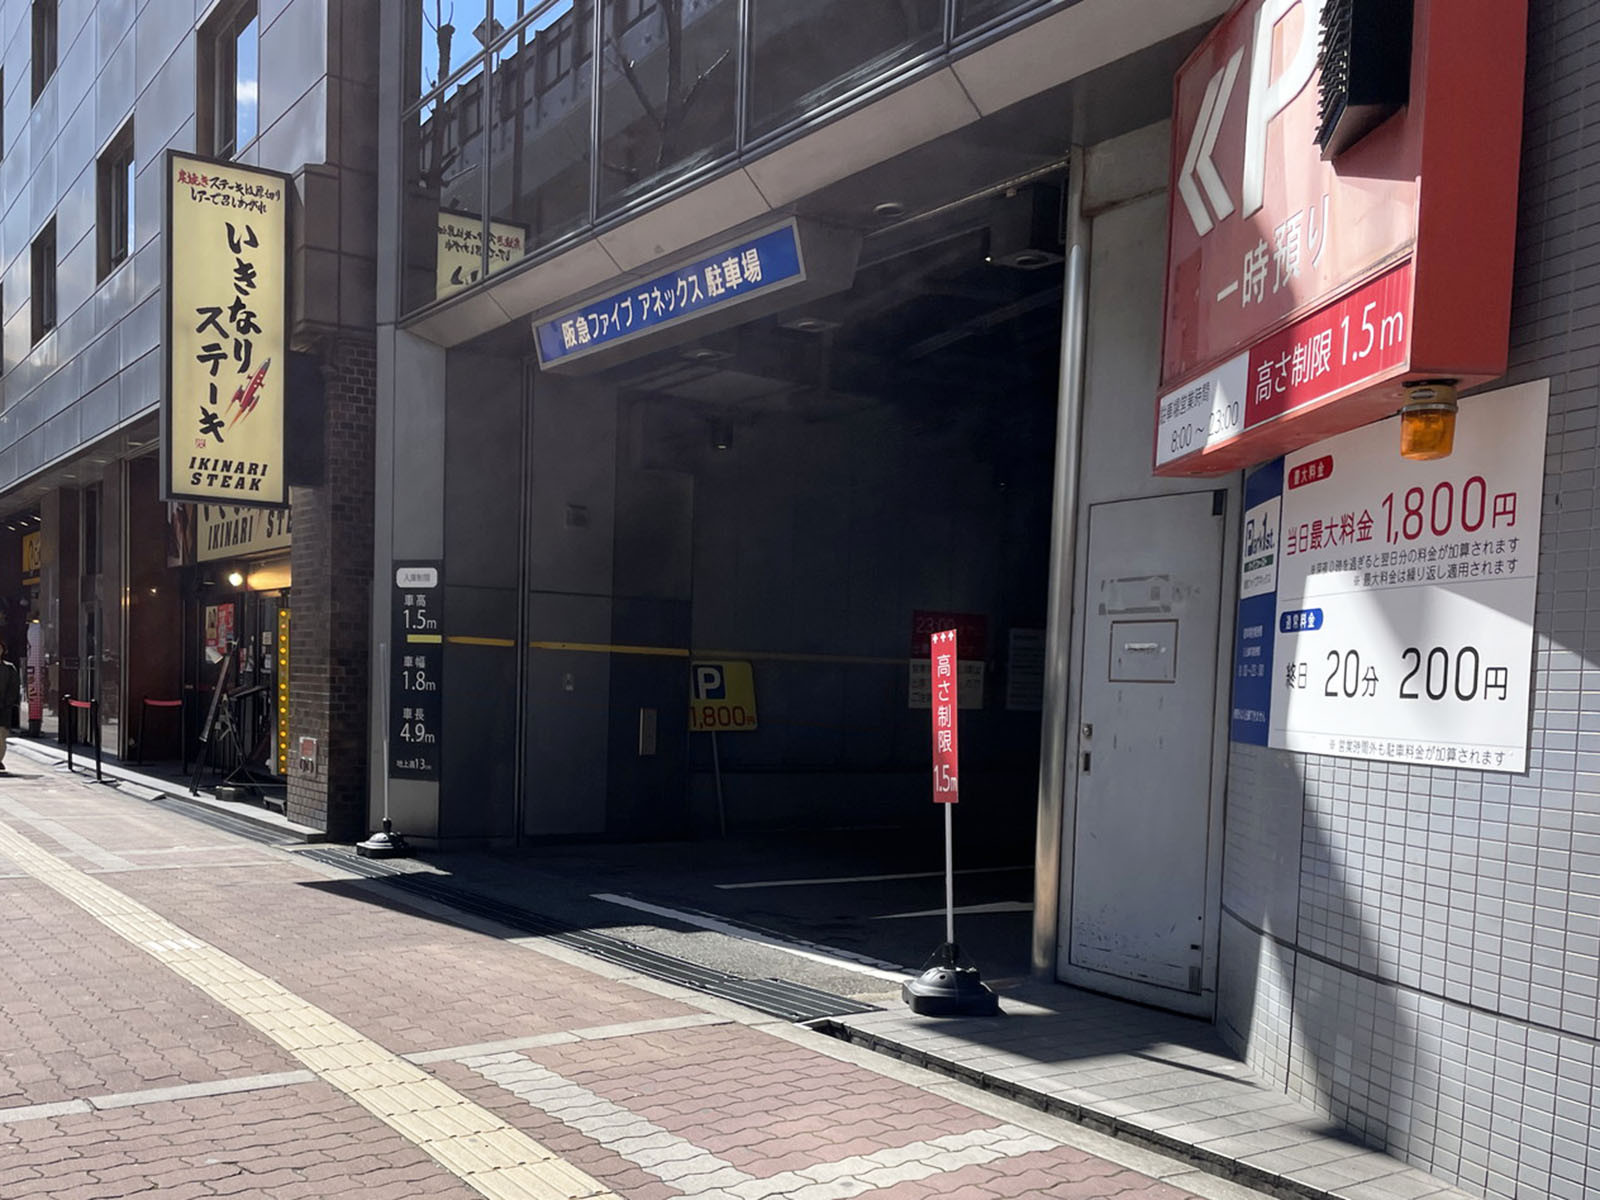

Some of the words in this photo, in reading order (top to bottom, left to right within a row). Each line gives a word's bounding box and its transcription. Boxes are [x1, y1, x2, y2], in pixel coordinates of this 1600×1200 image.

[1216, 193, 1330, 309] 一時預り
[224, 221, 263, 375] いきなり
[637, 274, 704, 321] アネックス
[705, 247, 763, 298] 駐車場
[195, 306, 230, 444] ステーキ
[1254, 327, 1333, 405] 高さ制限
[1339, 301, 1405, 367] 1.5m
[189, 456, 269, 477] IKINARI
[190, 472, 263, 491] STEAK
[208, 515, 254, 551] IKINARI
[1286, 509, 1375, 557] 当日最大料金
[1381, 476, 1518, 545] 1,800円
[403, 609, 437, 630] 1.5m
[402, 670, 437, 691] 1.8m
[1324, 649, 1380, 698] 20分
[1398, 646, 1509, 702] 200円
[936, 653, 953, 754] 高さ制限
[399, 722, 436, 744] 4.9m
[932, 764, 958, 793] 1.5m
